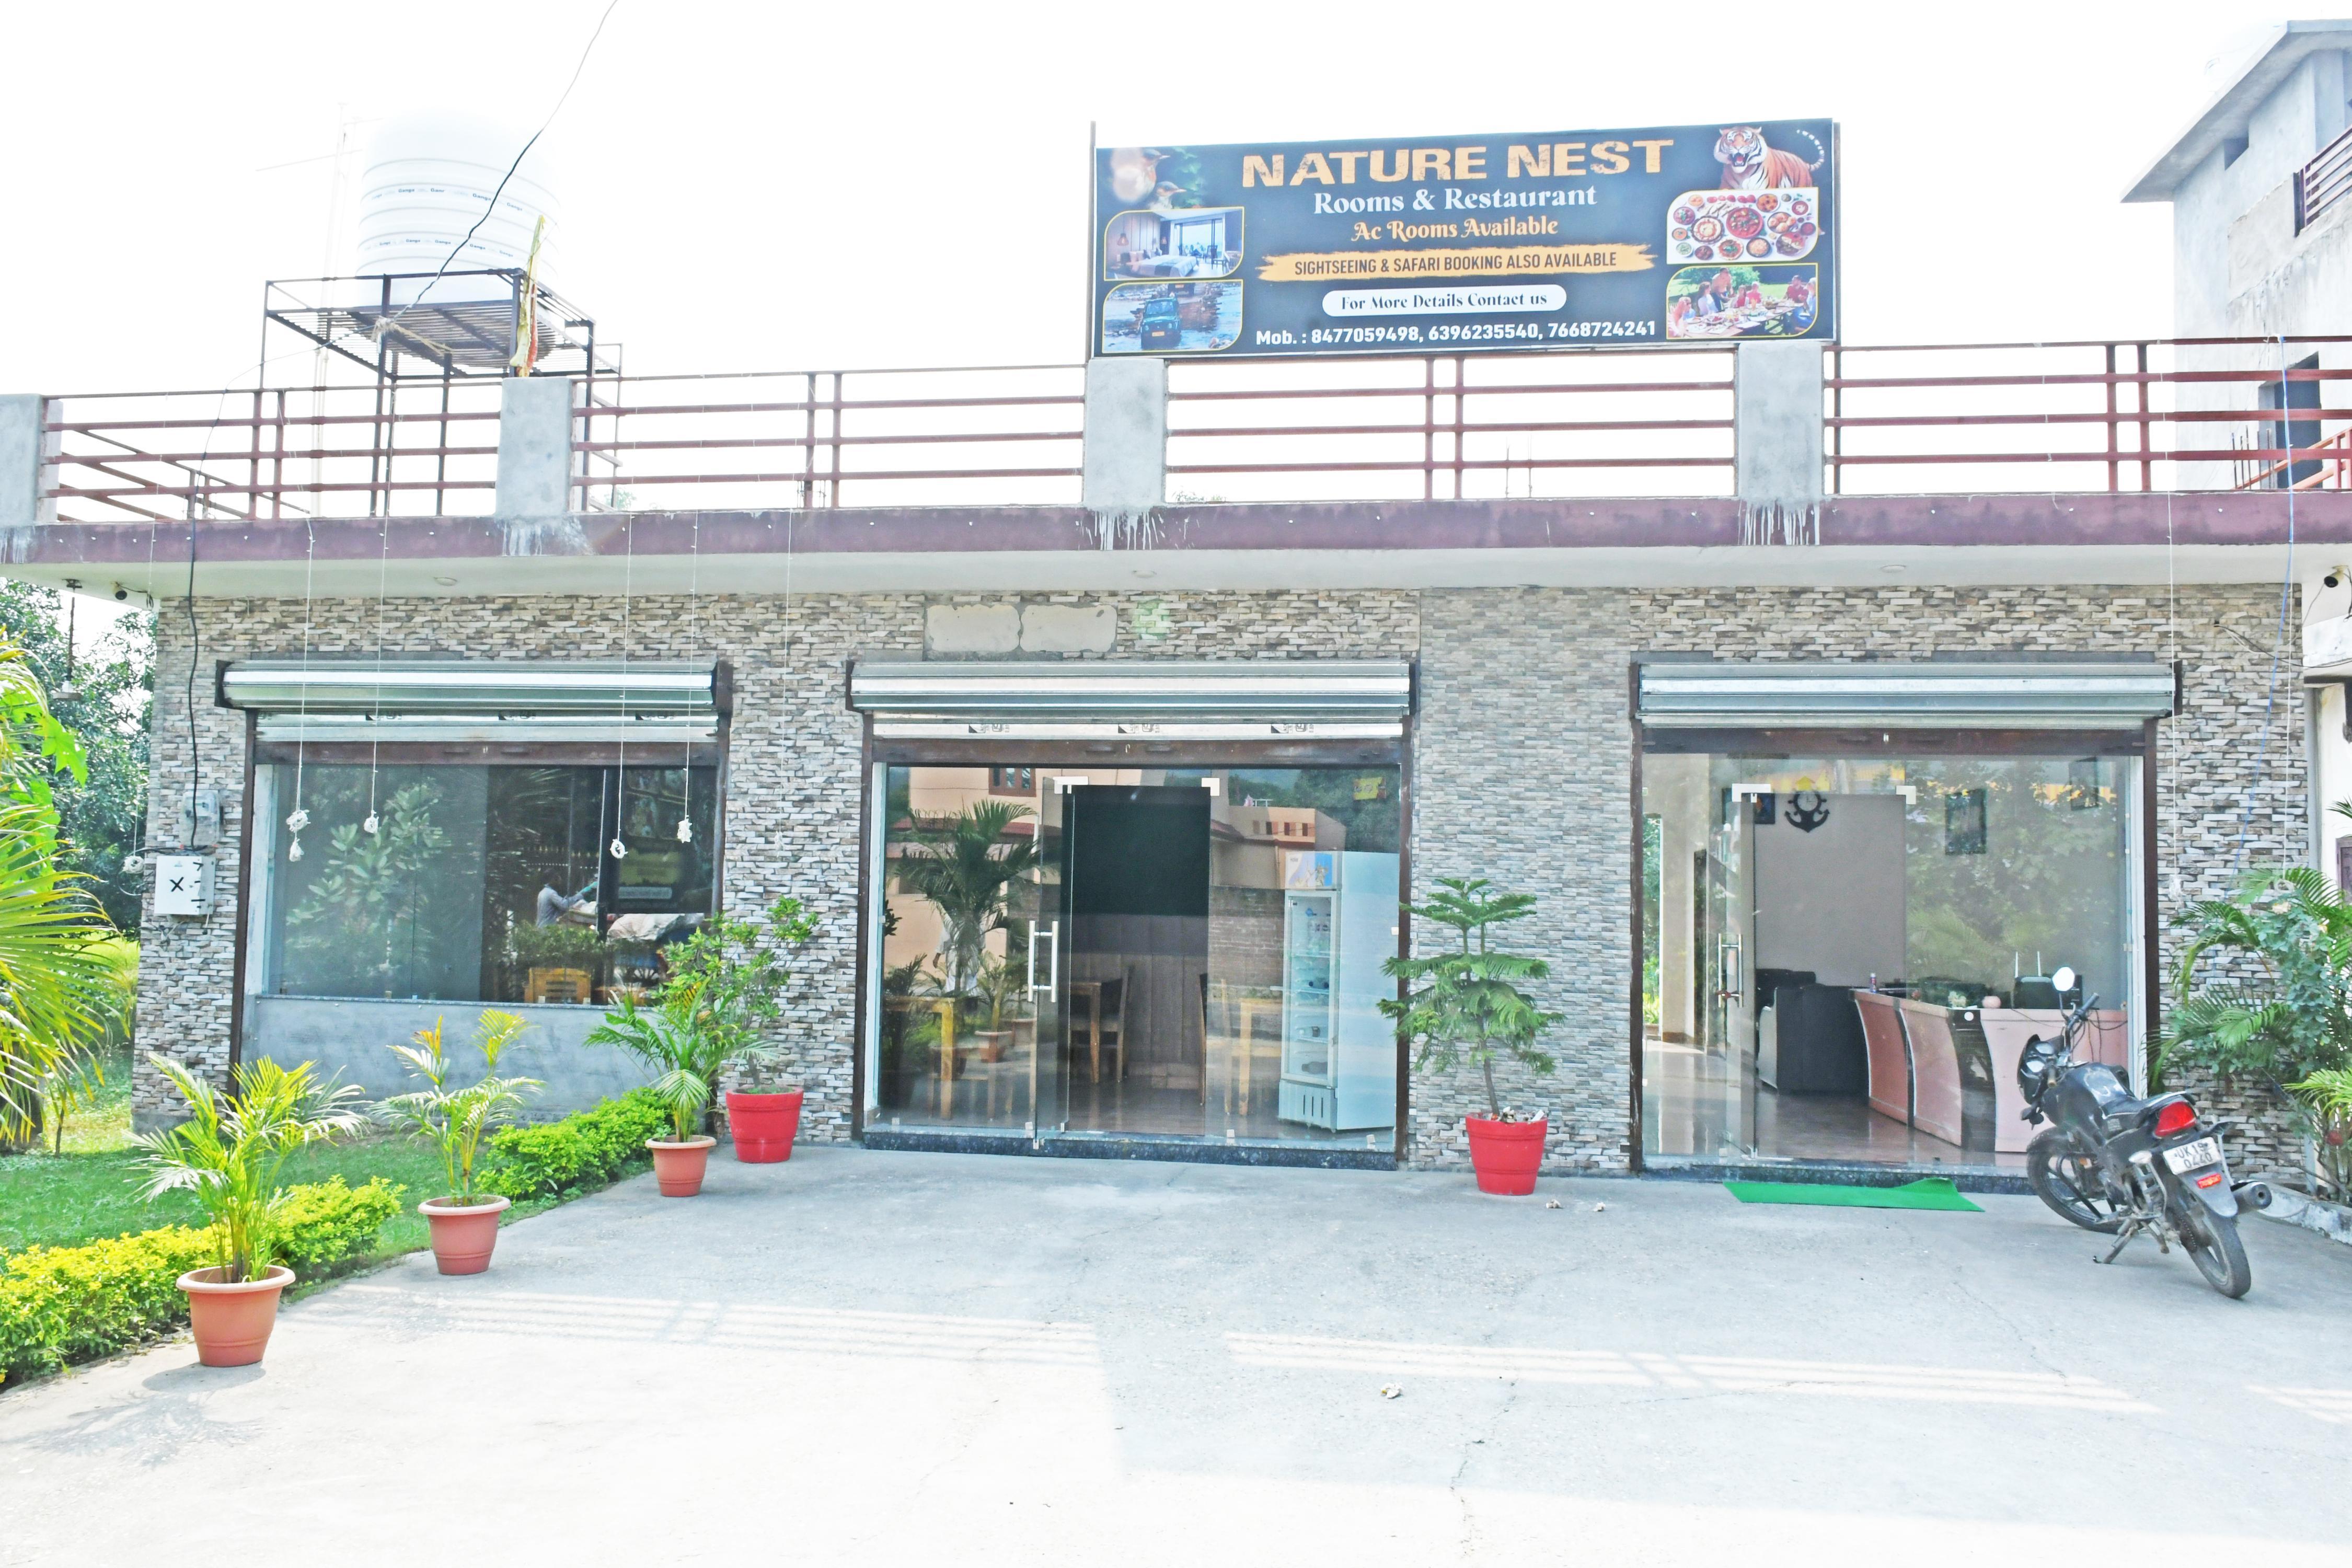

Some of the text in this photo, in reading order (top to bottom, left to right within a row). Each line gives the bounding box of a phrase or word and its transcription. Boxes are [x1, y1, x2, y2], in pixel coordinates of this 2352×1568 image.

[1242, 140, 1674, 187] NATURE NEST
[1314, 185, 1598, 214] Rooms & Restaurant
[1351, 215, 1558, 242] Ac Rooms Available
[1295, 252, 1617, 275] SIGHTSEEING & SAFARI BOOKING ALSO AVAILABLE
[1342, 293, 1547, 309] For More Details Contact us
[1256, 330, 1297, 345] Mob.
[1311, 327, 1424, 343] 8477059498,
[1428, 324, 1543, 340] 6396235540,
[1548, 320, 1655, 338] 7668724241
